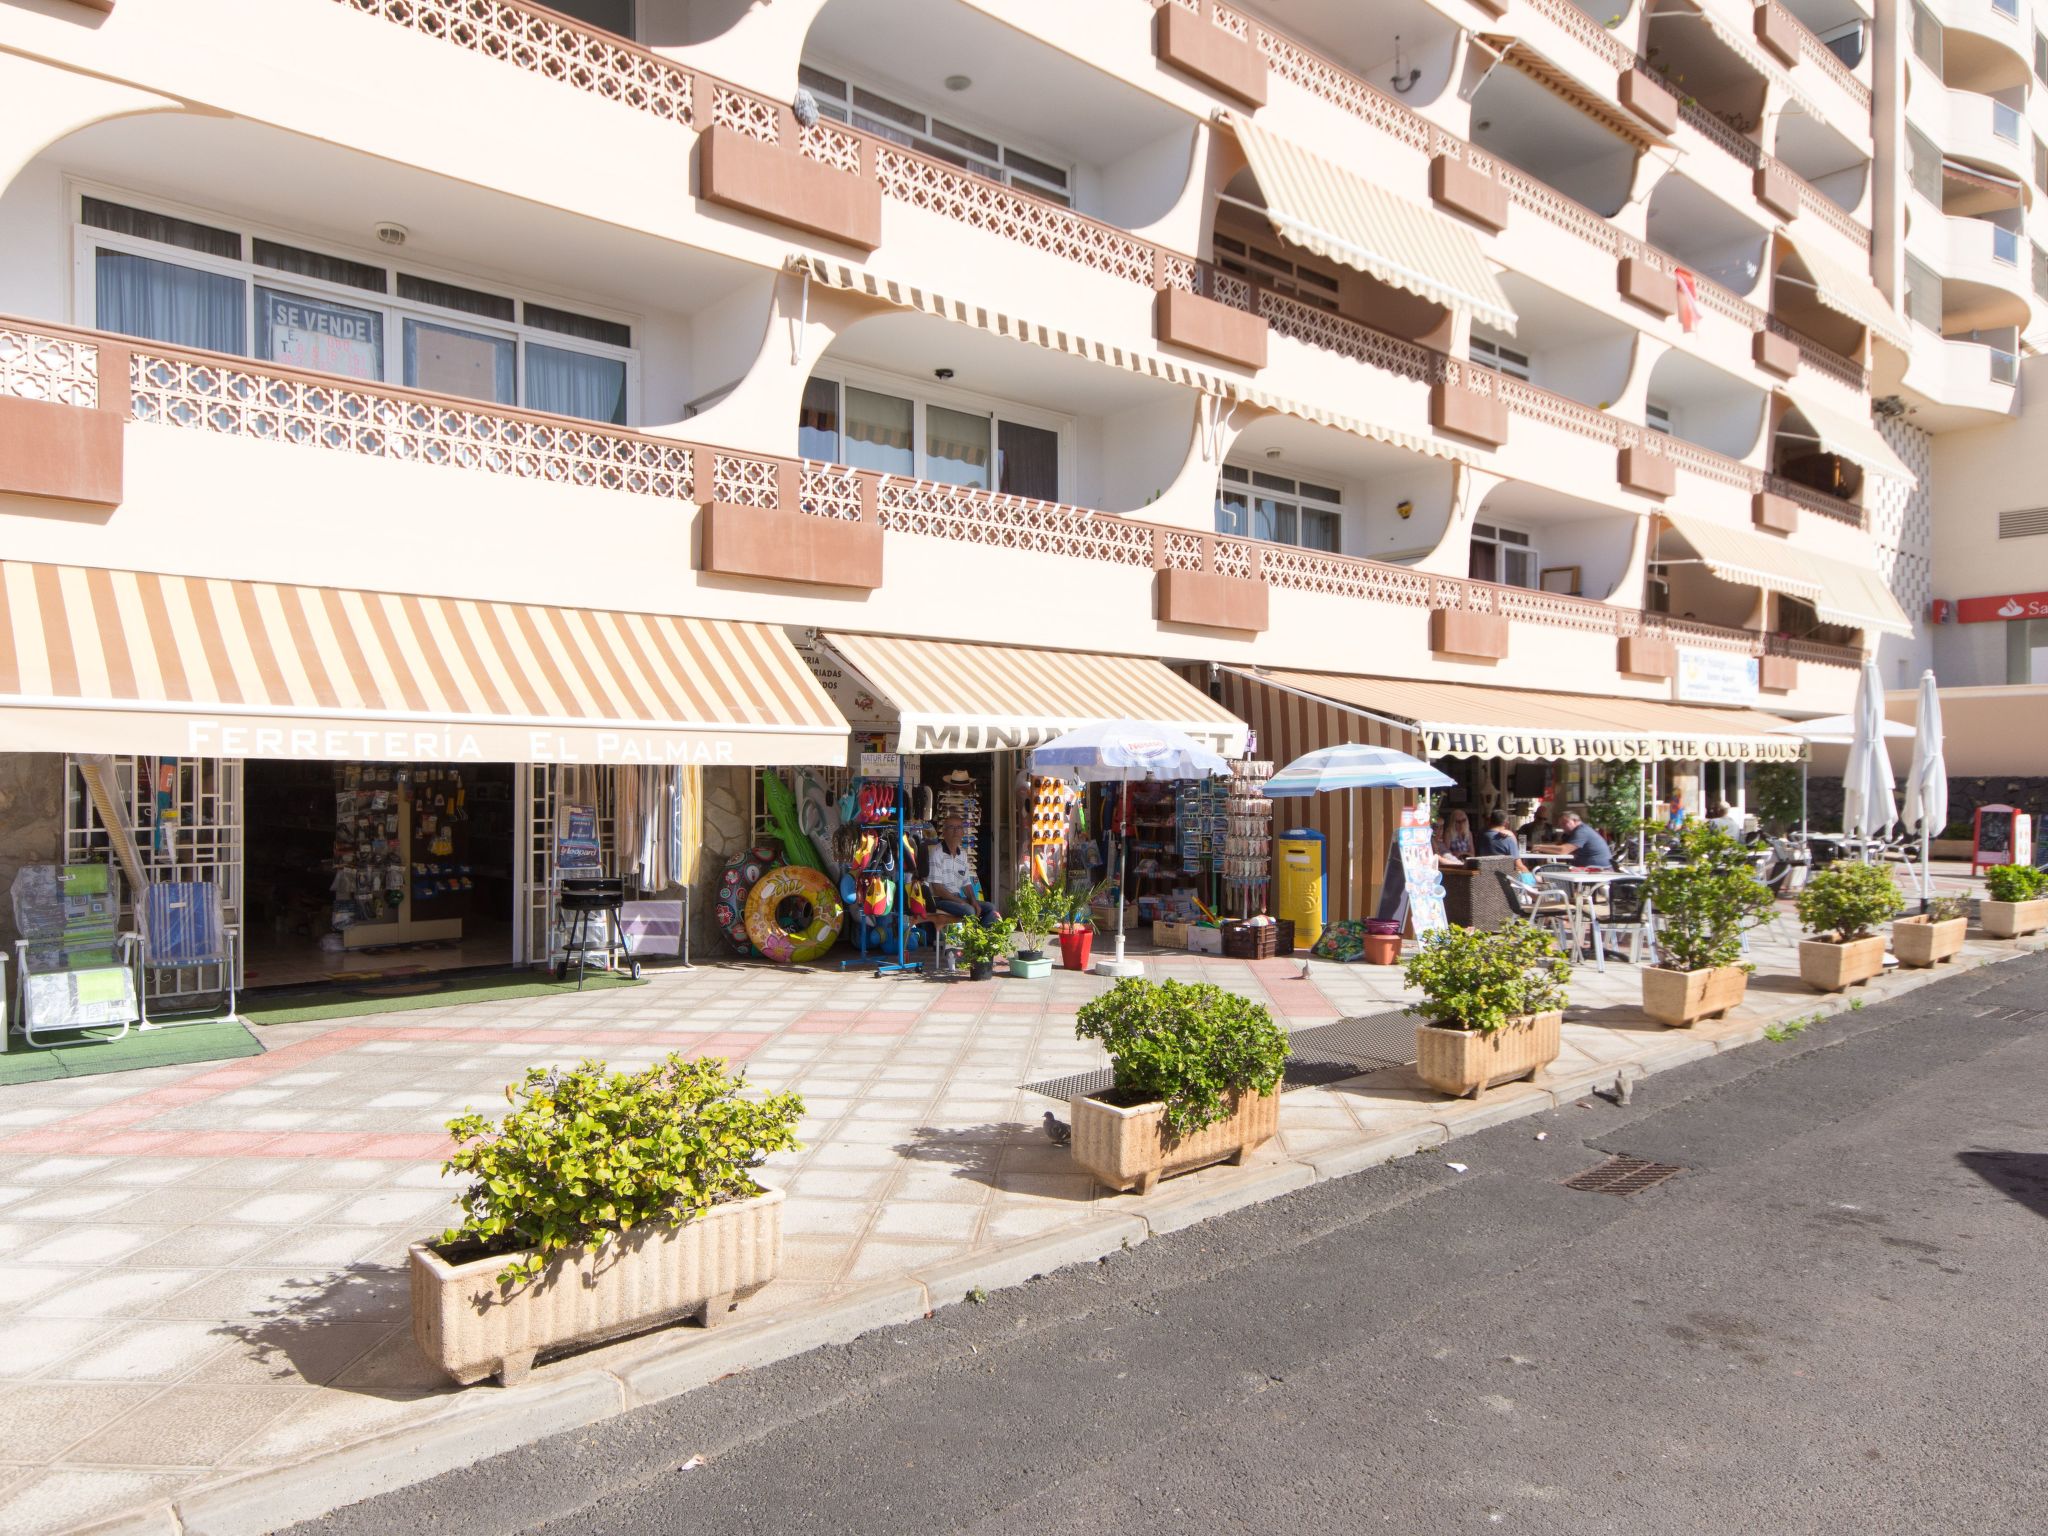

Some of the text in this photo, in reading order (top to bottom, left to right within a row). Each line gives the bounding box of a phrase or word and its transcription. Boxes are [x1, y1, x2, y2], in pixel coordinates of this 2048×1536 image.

[277, 304, 366, 340] SE VENDE
[187, 720, 734, 763] FERRETERÍA EL PALMAR
[1425, 731, 1650, 757] THE CLUB HOUSE
[1657, 739, 1808, 759] THE CLUB HOUSE
